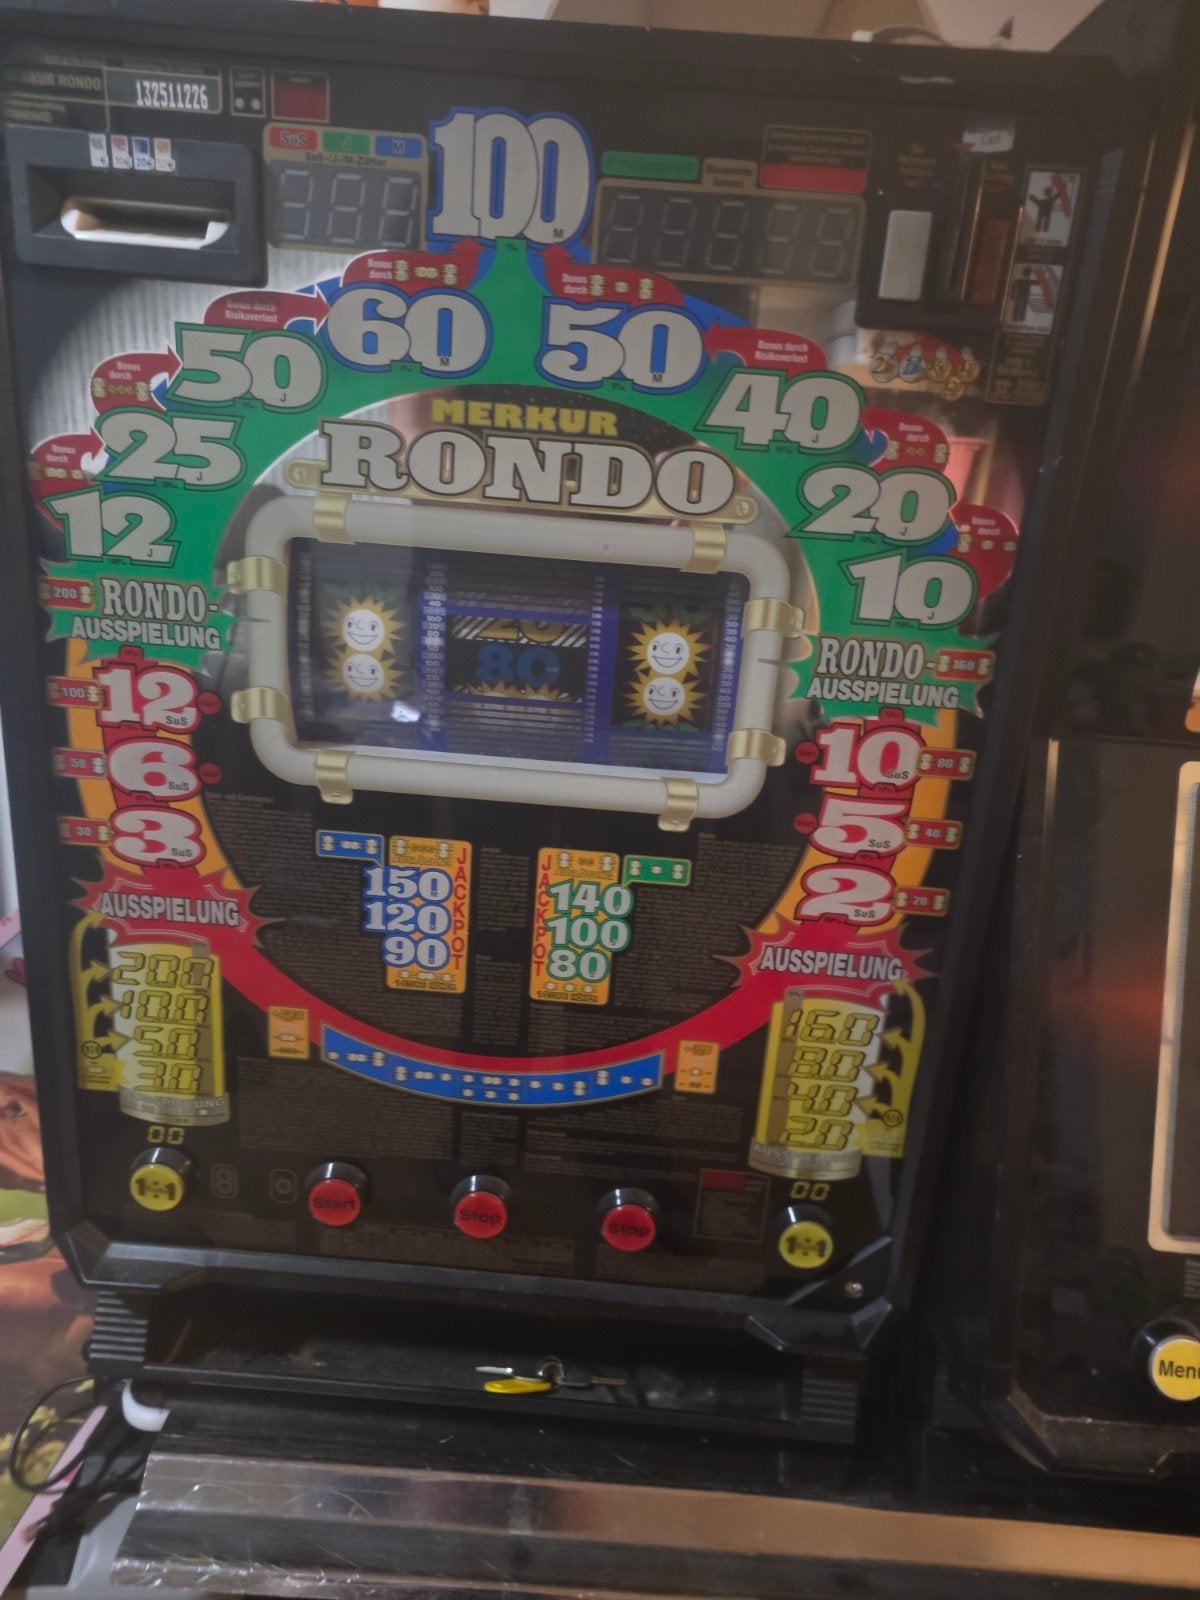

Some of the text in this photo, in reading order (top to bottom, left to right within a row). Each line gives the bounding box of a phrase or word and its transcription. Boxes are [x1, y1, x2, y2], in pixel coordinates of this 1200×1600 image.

[57, 73, 102, 91] RONDO
[136, 80, 209, 111] 132511226
[280, 132, 307, 147] SuS
[343, 136, 353, 150] J
[391, 140, 405, 153] M
[433, 112, 590, 244] 100
[552, 228, 564, 239] M
[367, 259, 393, 269] Bonus
[369, 270, 393, 280] durch
[562, 273, 588, 283] Bonus
[564, 284, 588, 295] durch
[225, 310, 278, 322] Risikoverlust
[226, 300, 277, 312] Bonus durch
[328, 287, 487, 372] 60
[440, 358, 449, 367] M
[541, 304, 703, 389] 50
[754, 350, 809, 363] Risikoverlust
[757, 340, 809, 353] Bonus durch
[109, 371, 132, 380] durch
[117, 361, 141, 371] Bonus
[173, 329, 322, 411] 50
[431, 399, 618, 437] MERKUR
[704, 372, 862, 452] 40
[899, 422, 924, 433] Bonus
[52, 444, 76, 454] Bonus
[100, 413, 243, 486] 25
[907, 432, 930, 443] durch
[320, 419, 736, 516] RONDO
[802, 465, 953, 542] 20
[48, 487, 174, 564] 12
[971, 516, 996, 527] Bonus
[978, 526, 1001, 536] durch
[54, 587, 77, 599] 200
[101, 578, 219, 623] RONDO-
[847, 554, 973, 626] 10
[71, 616, 221, 650] AUSSPIELUNG
[816, 637, 937, 681] RONDO-
[62, 686, 85, 698] 100
[97, 666, 198, 732] 12
[805, 676, 959, 709] AUSSPIELUNG
[166, 715, 188, 726] SuS
[109, 740, 199, 797] 6
[813, 724, 924, 787] 10
[168, 781, 191, 792] SuS
[886, 769, 909, 780] SuS
[114, 809, 202, 863] 3
[812, 796, 908, 859] 5
[868, 838, 891, 849] SuS
[171, 847, 193, 858] SuS
[365, 867, 451, 901] 150
[547, 882, 632, 916] 140
[800, 863, 895, 927] 2
[100, 891, 240, 927] AUSSPIELUNG
[365, 901, 449, 935] 120
[451, 847, 468, 970] JACKPOT
[533, 854, 552, 977] JACKPOT
[854, 908, 876, 919] SuS
[547, 916, 629, 951] 100
[384, 936, 449, 968] 90
[548, 949, 608, 981] 80
[760, 948, 904, 983] AUSSPIELUNG
[111, 951, 215, 991] 200
[120, 989, 209, 1026] 100
[133, 1025, 200, 1060] 50
[785, 1008, 880, 1047] 160
[134, 1060, 203, 1095] 30
[788, 1046, 866, 1083] 80
[786, 1081, 859, 1117] 40
[147, 1125, 186, 1145] 00
[780, 1115, 855, 1151] 20
[312, 1195, 358, 1211] Start
[790, 1181, 831, 1200] 00
[459, 1208, 501, 1226] Stop
[607, 1222, 651, 1239] Stop
[1159, 1360, 1200, 1379] Men
